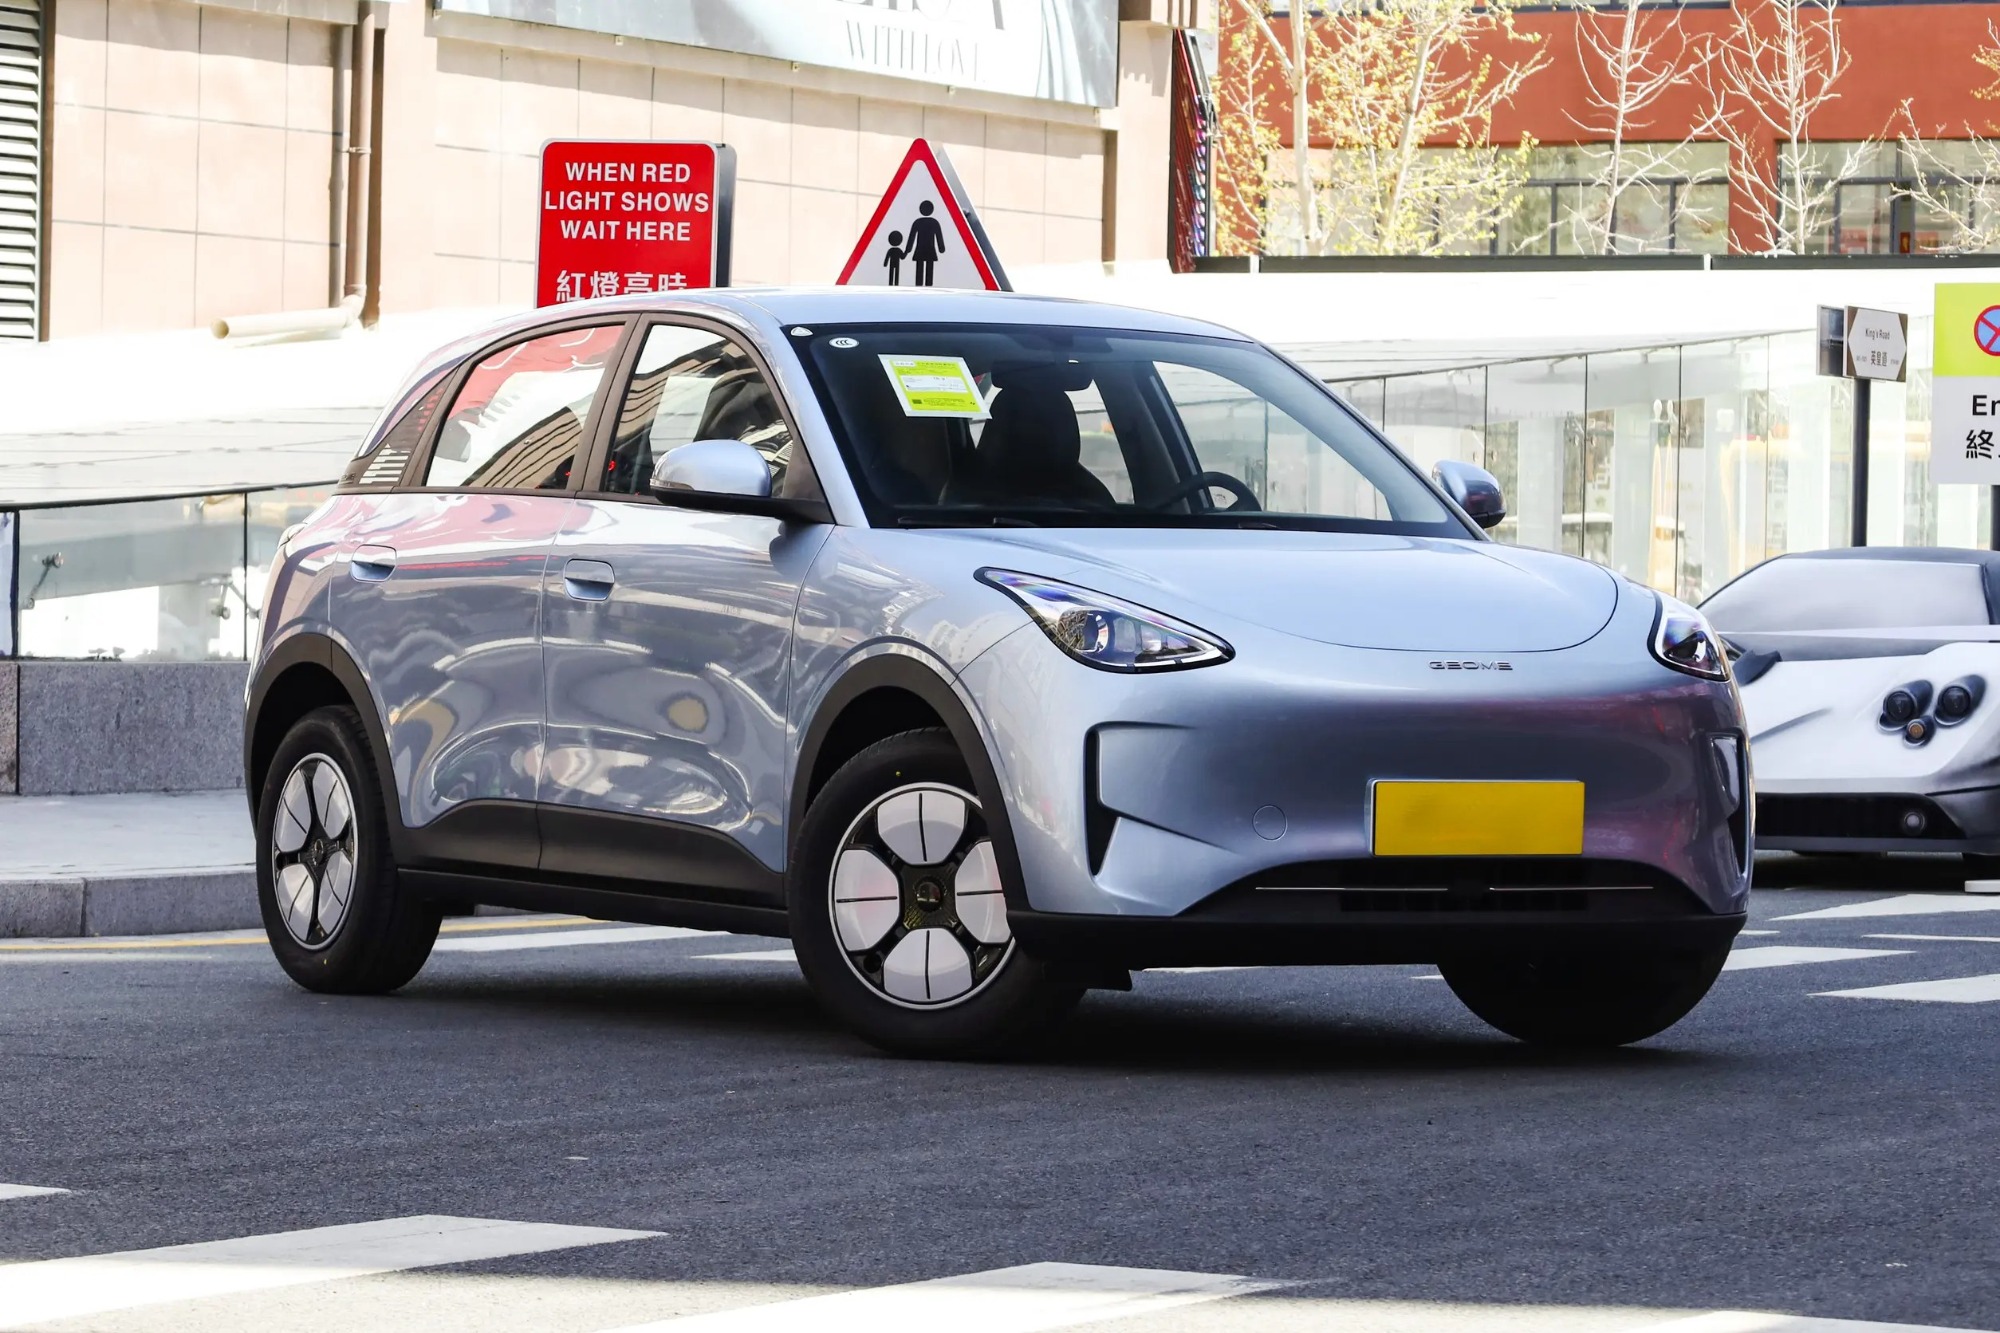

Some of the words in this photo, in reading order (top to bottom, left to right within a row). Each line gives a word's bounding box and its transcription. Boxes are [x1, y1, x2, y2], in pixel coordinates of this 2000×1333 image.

[565, 162, 635, 182] WHEN
[642, 163, 691, 183] RED
[545, 191, 615, 211] LIGHT
[620, 192, 709, 213] SHOWS
[560, 220, 620, 240] WAIT
[626, 221, 691, 241] HERE
[1879, 329, 1890, 340] Road
[1966, 429, 2000, 460] 終
[1429, 661, 1513, 671] GEOME
